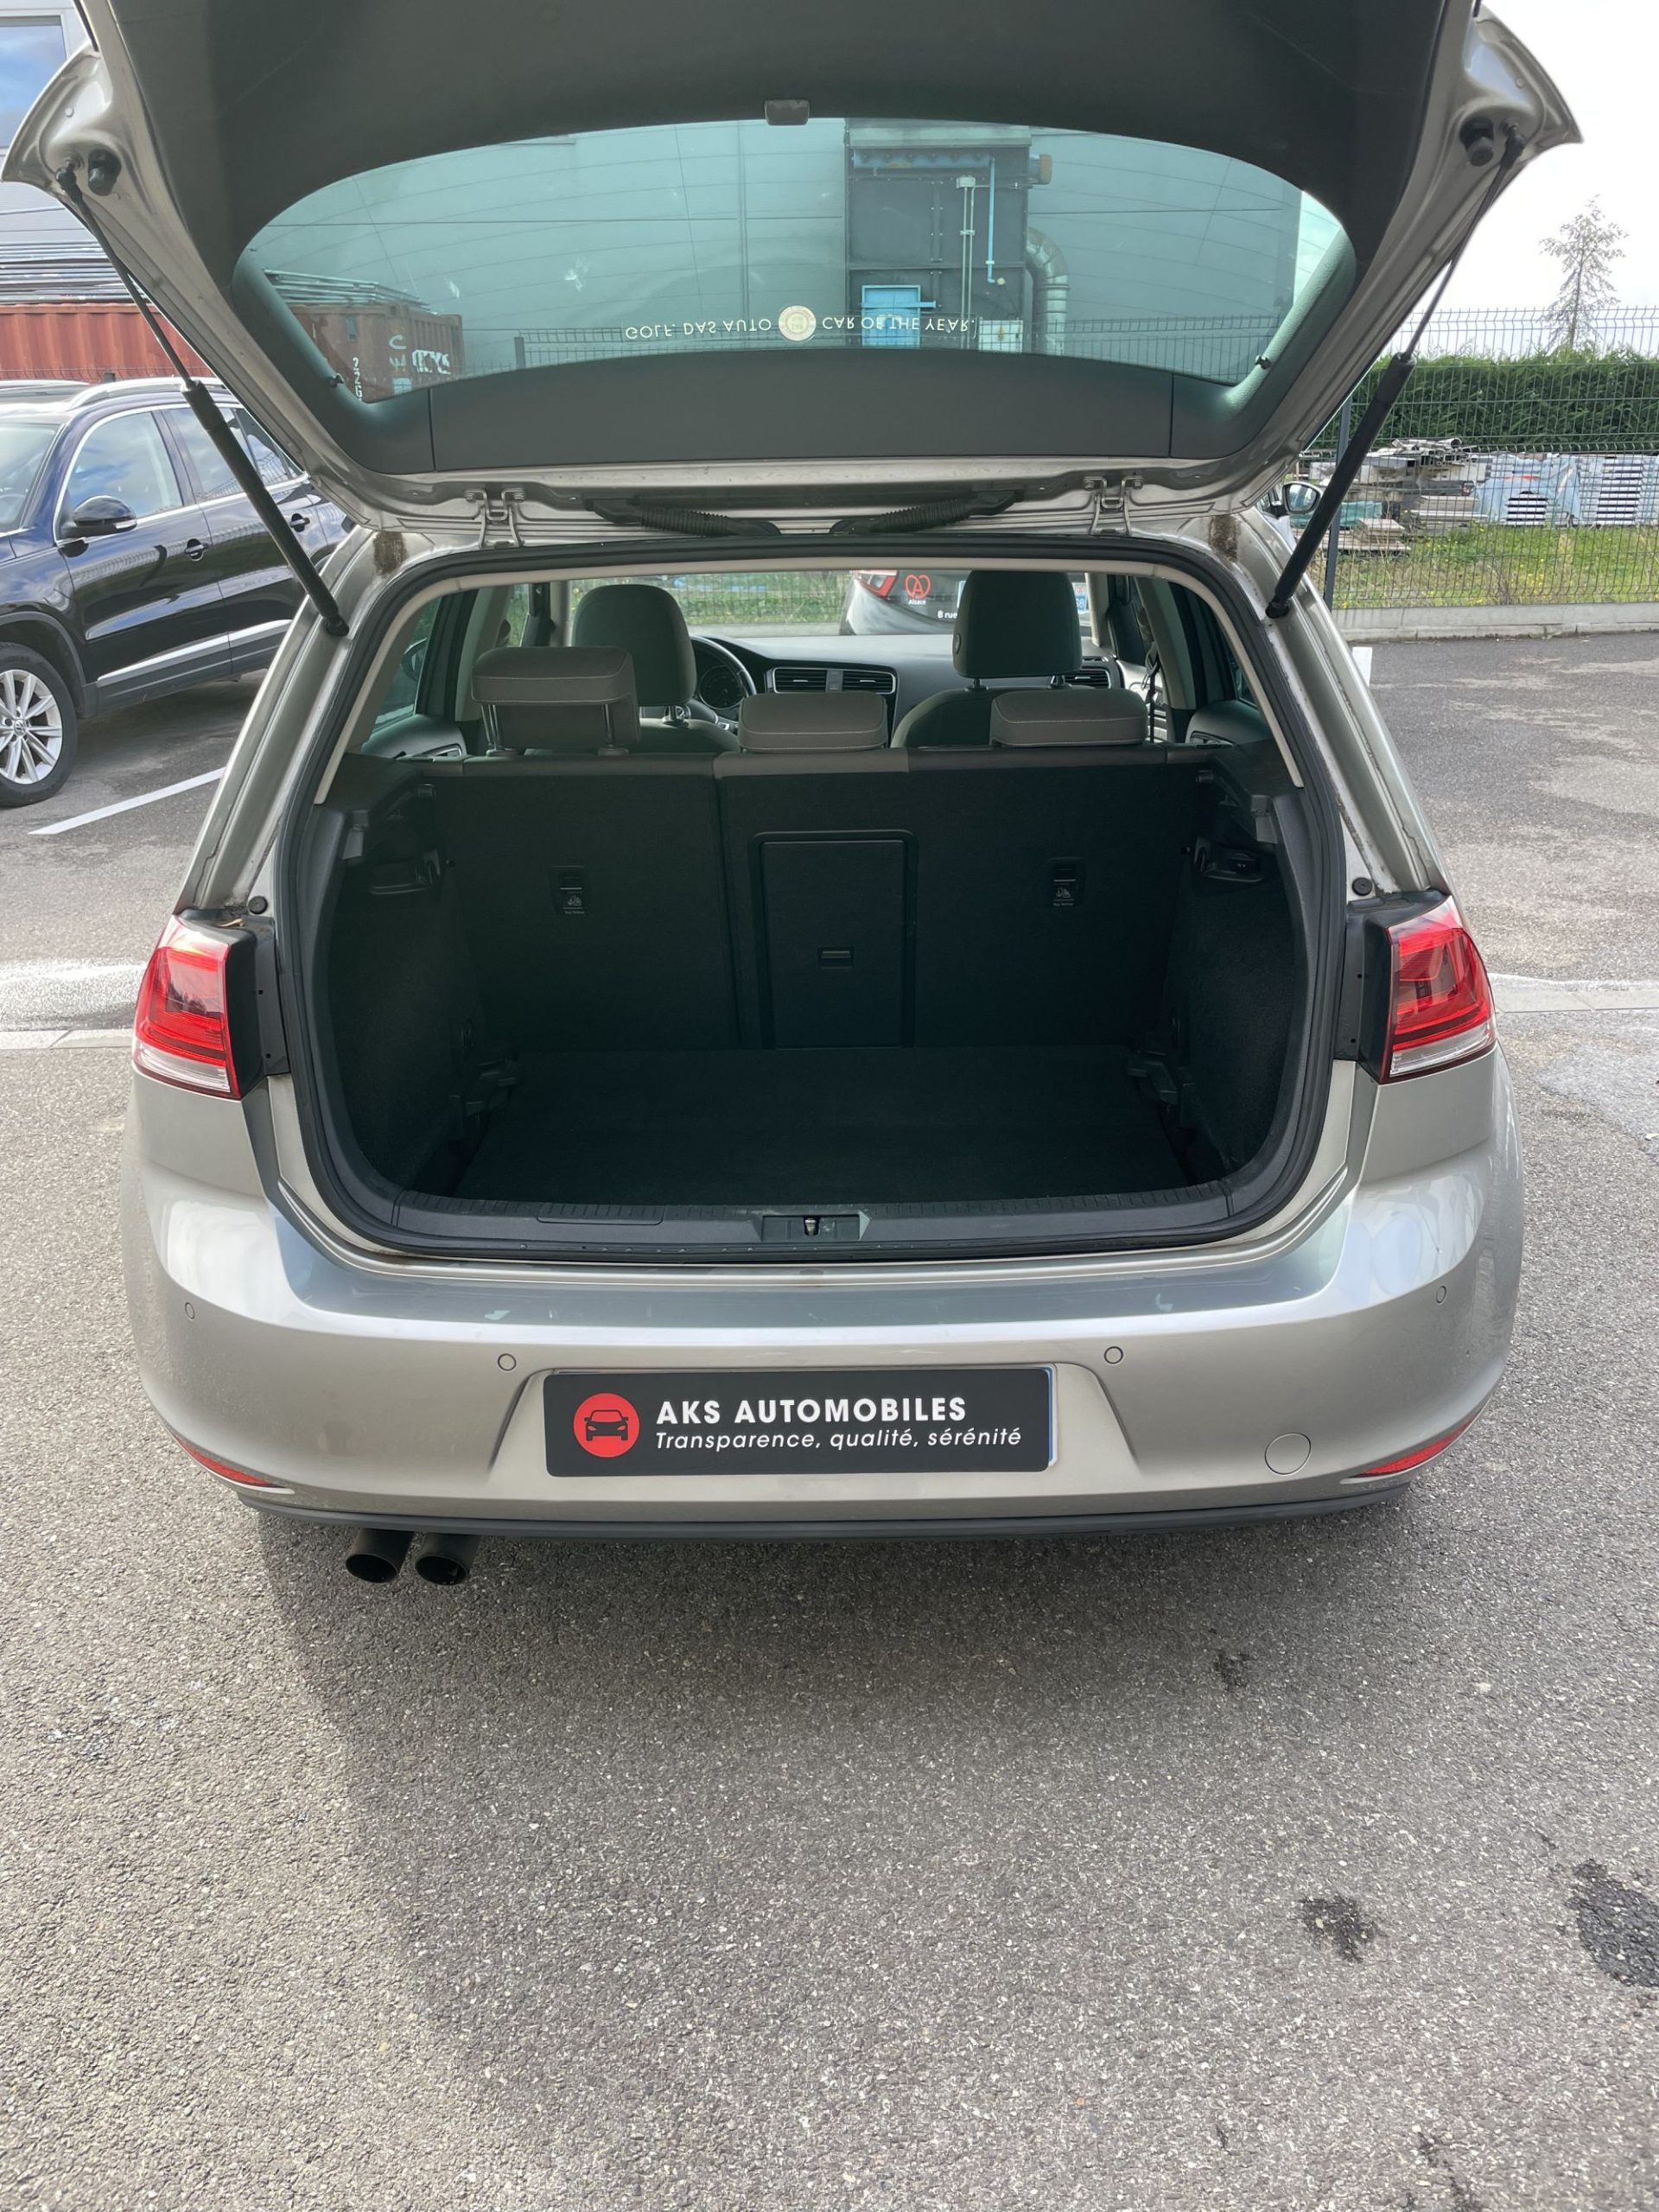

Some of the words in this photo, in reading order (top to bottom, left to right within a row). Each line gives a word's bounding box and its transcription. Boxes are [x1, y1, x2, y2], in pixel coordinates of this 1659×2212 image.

[353, 357, 363, 401] 22G
[656, 1400, 721, 1424] AKS
[734, 1396, 966, 1424] AUTOMOBILES
[656, 1432, 821, 1452] Transparence,
[830, 1427, 918, 1451] qualité,
[927, 1427, 1021, 1446] sérénité
